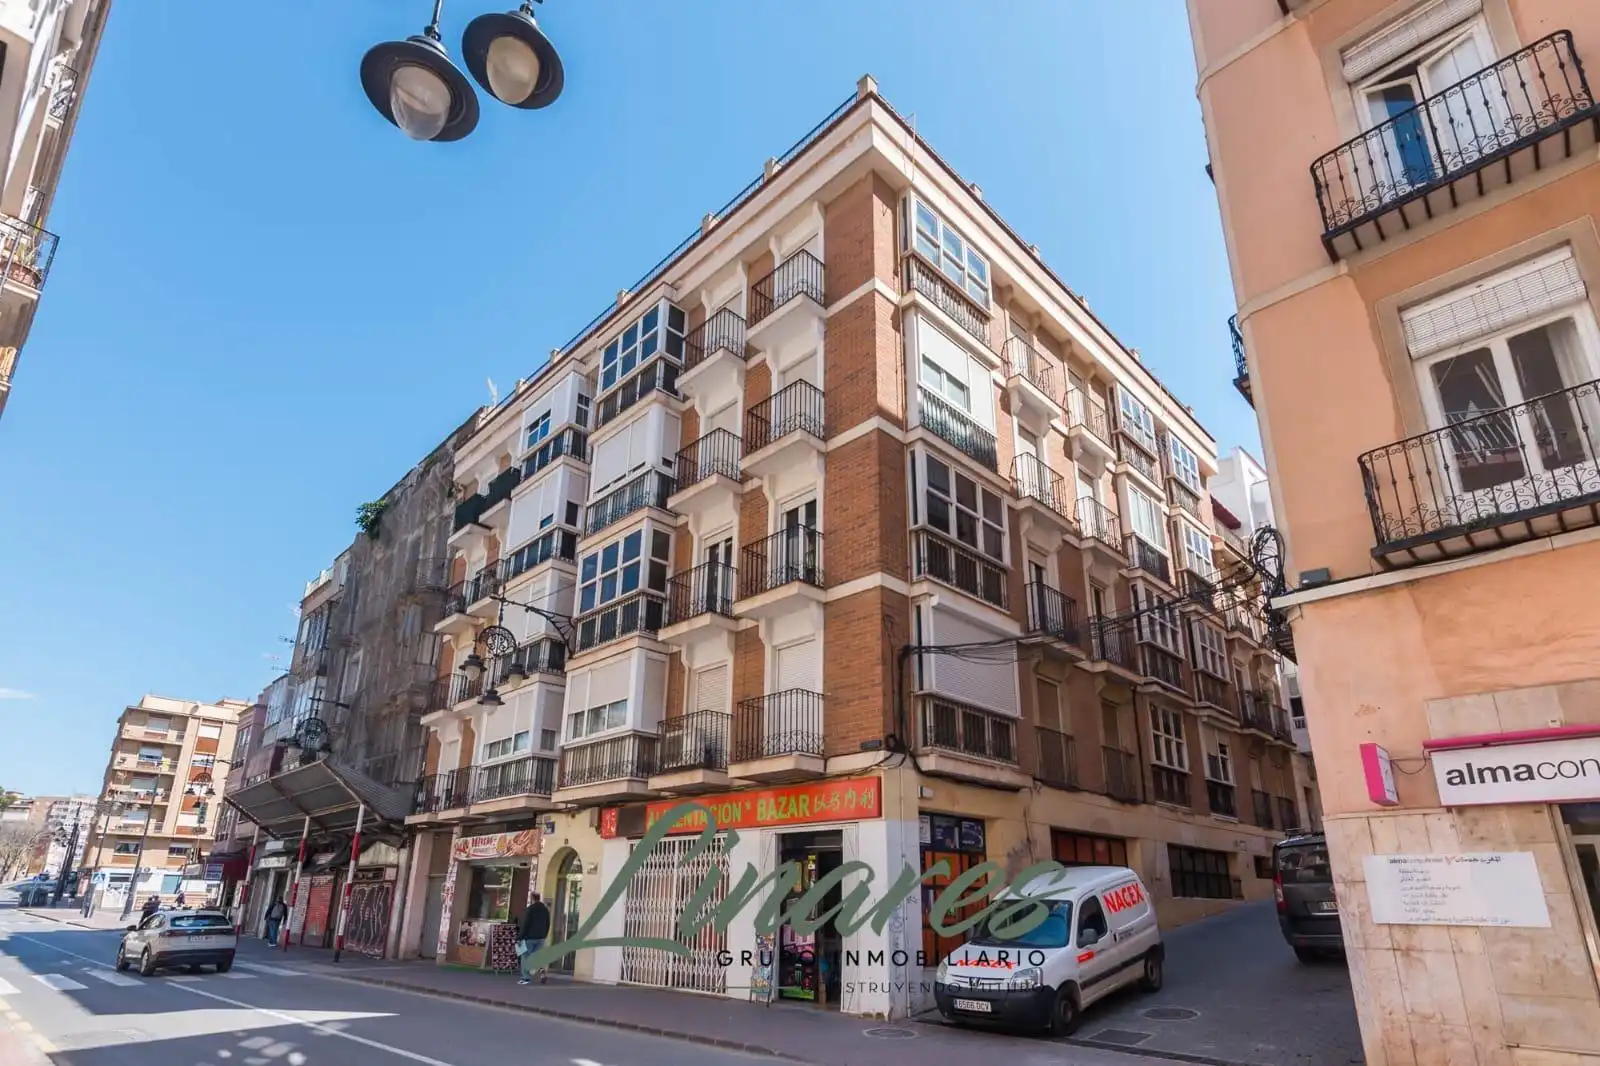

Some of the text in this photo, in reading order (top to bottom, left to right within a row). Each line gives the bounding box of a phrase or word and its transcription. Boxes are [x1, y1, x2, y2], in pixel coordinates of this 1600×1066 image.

[1445, 758, 1600, 786] almacon
[757, 794, 810, 821] BAZAR
[1103, 882, 1145, 914] NACEX
